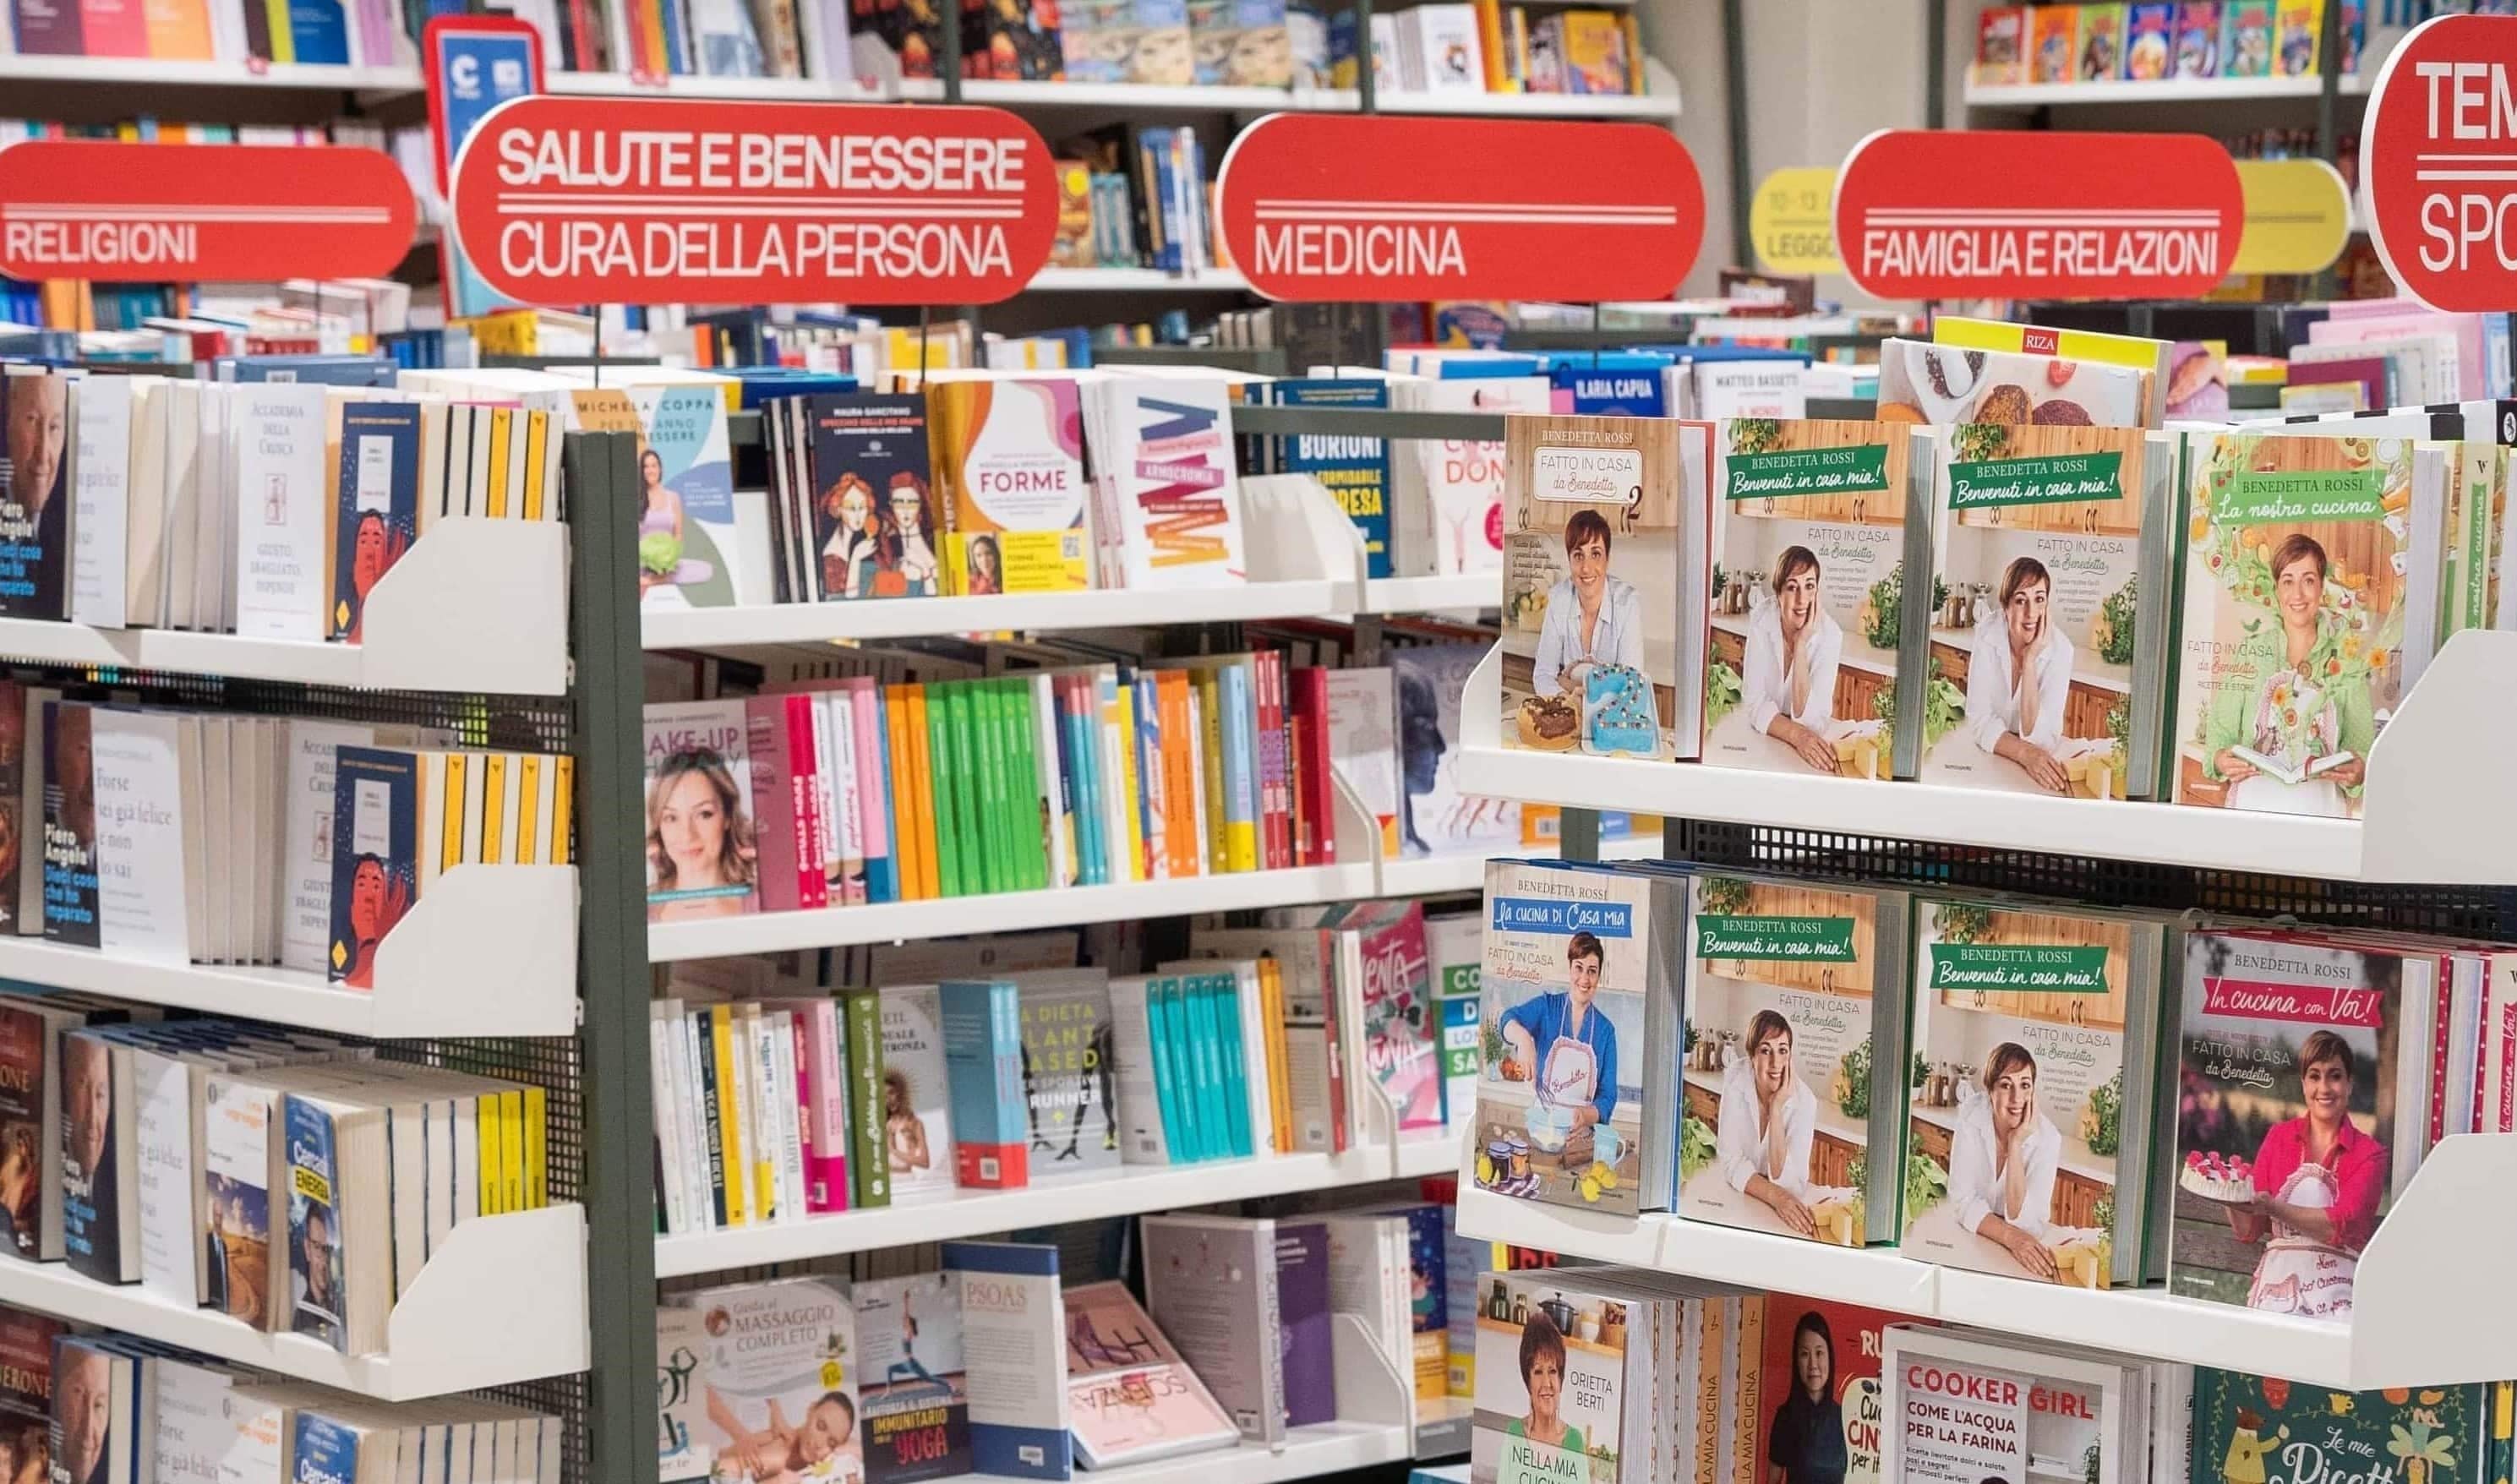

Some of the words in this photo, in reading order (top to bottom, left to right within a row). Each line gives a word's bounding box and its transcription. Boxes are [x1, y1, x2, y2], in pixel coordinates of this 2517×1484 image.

[498, 128, 693, 187] SALUTE
[701, 134, 732, 187] E
[739, 135, 1026, 191] BENESSERE
[6, 221, 197, 264] RELIGIONI
[500, 221, 637, 277] CURA
[645, 223, 789, 277] DELLA
[797, 225, 1013, 278] PERSONA
[1255, 225, 1467, 277] MEDICINA
[1863, 229, 2021, 278] FAMIGLIA
[2028, 229, 2049, 276] E
[2055, 228, 2219, 277] RELAZIONI
[2026, 333, 2056, 352] RIZA
[1576, 379, 1613, 399] ILARIA
[1615, 379, 1653, 397] CAPUA
[1716, 374, 1754, 387] MATTEO
[663, 399, 713, 412] COPPA
[1299, 434, 1382, 461] BURIONI
[1542, 430, 1601, 443] BENEDETTA
[1605, 432, 1633, 445] ROSSI
[1541, 455, 1578, 471] FATTO
[1581, 456, 1594, 471] IN
[1597, 458, 1632, 472] CASA
[1752, 454, 1817, 470] BENEDETTA
[1823, 452, 1854, 465] ROSSI
[1977, 461, 2048, 477] BENEDETTA
[2053, 460, 2088, 473] ROSSI
[980, 470, 1067, 494] FORME
[1553, 473, 1565, 489] da
[1568, 472, 1617, 496] Benedetta
[1734, 472, 1795, 494] Benvenuti
[1796, 472, 1813, 488] in
[1816, 474, 1845, 487] casa
[1846, 464, 1881, 485] mia!
[1956, 480, 2023, 504] Benvenuti
[2024, 479, 2042, 498] in
[2045, 482, 2076, 497] casa
[2077, 472, 2115, 493] mia!
[2242, 480, 2318, 494] BENEDETTA
[2324, 478, 2364, 492] ROSSI
[2218, 495, 2242, 519] La
[2247, 499, 2307, 518] nostra
[2312, 499, 2377, 515] cucina
[1808, 528, 1842, 542] FATTO
[1844, 529, 1854, 542] IN
[1858, 530, 1891, 543] CASA
[2037, 538, 2073, 553] FATTO
[2076, 540, 2087, 554] IN
[2090, 541, 2124, 554] CASA
[2187, 641, 2222, 655] FATTO
[2239, 643, 2274, 657] CASA
[649, 727, 740, 756] AKE-UP
[1518, 879, 1575, 897] BENEDETTA
[1579, 887, 1608, 901] ROSSI
[1723, 919, 1786, 933] BENEDETTA
[1790, 921, 1821, 934] ROSSI
[1703, 931, 1766, 954] Benvenuti
[1766, 938, 1783, 955] in
[1784, 942, 1812, 955] casa
[1814, 936, 1849, 955] mia!
[1961, 948, 2032, 963] BENEDETTA
[2038, 951, 2072, 963] ROSSI
[1488, 947, 1515, 962] FATTO
[1517, 952, 1526, 963] IN
[1528, 953, 1554, 967] CASA
[2235, 954, 2309, 974] BENEDETTA
[2314, 964, 2351, 979] ROSSI
[1939, 960, 2007, 984] Benvenuti
[2008, 967, 2028, 984] in
[2030, 971, 2061, 985] casa
[2063, 966, 2101, 986] mia!
[1779, 993, 1812, 1007] FATTO
[1815, 999, 1825, 1010] IN
[1827, 1001, 1860, 1014] CASA
[2210, 977, 2227, 1008] In
[2230, 989, 2301, 1013] cucina
[2304, 1002, 2327, 1016] con
[2329, 987, 2376, 1023] Voi!
[1026, 1023, 1097, 1050] LANT
[2023, 1026, 2059, 1041] FATTO
[2062, 1030, 2073, 1042] IN
[2076, 1033, 2110, 1047] CASA
[1029, 1048, 1100, 1072] ASED
[2192, 1040, 2233, 1057] FATTO
[2237, 1047, 2248, 1060] IN
[2253, 1049, 2291, 1066] CASA
[2205, 1061, 2219, 1075] da
[2221, 1059, 2274, 1088] Benedetta
[967, 1283, 1027, 1306] PSOAS
[736, 1304, 833, 1333] MASSAGGIO
[736, 1326, 818, 1352] COMPLETO
[1570, 1371, 1613, 1394] ORIETTA
[1907, 1366, 2018, 1406] COOKER
[1576, 1391, 1604, 1413] BERTI
[1705, 1375, 1718, 1434] CUCINA
[1744, 1370, 1756, 1427] CUCINA
[2028, 1385, 2094, 1420] GIRL
[873, 1408, 947, 1434] IMMUNITARIO
[1907, 1401, 1949, 1421] COME
[1955, 1409, 2016, 1434] L'ACQUA
[1743, 1432, 1754, 1459] MIA
[1907, 1421, 1934, 1438] PER
[1939, 1427, 1957, 1443] LA
[1963, 1432, 2017, 1454] FARINA
[2323, 1426, 2345, 1454] Le
[2348, 1439, 2376, 1458] mie
[1512, 1446, 1552, 1471] NELLA
[1554, 1459, 1577, 1481] MIA
[1703, 1438, 1715, 1464] MIA
